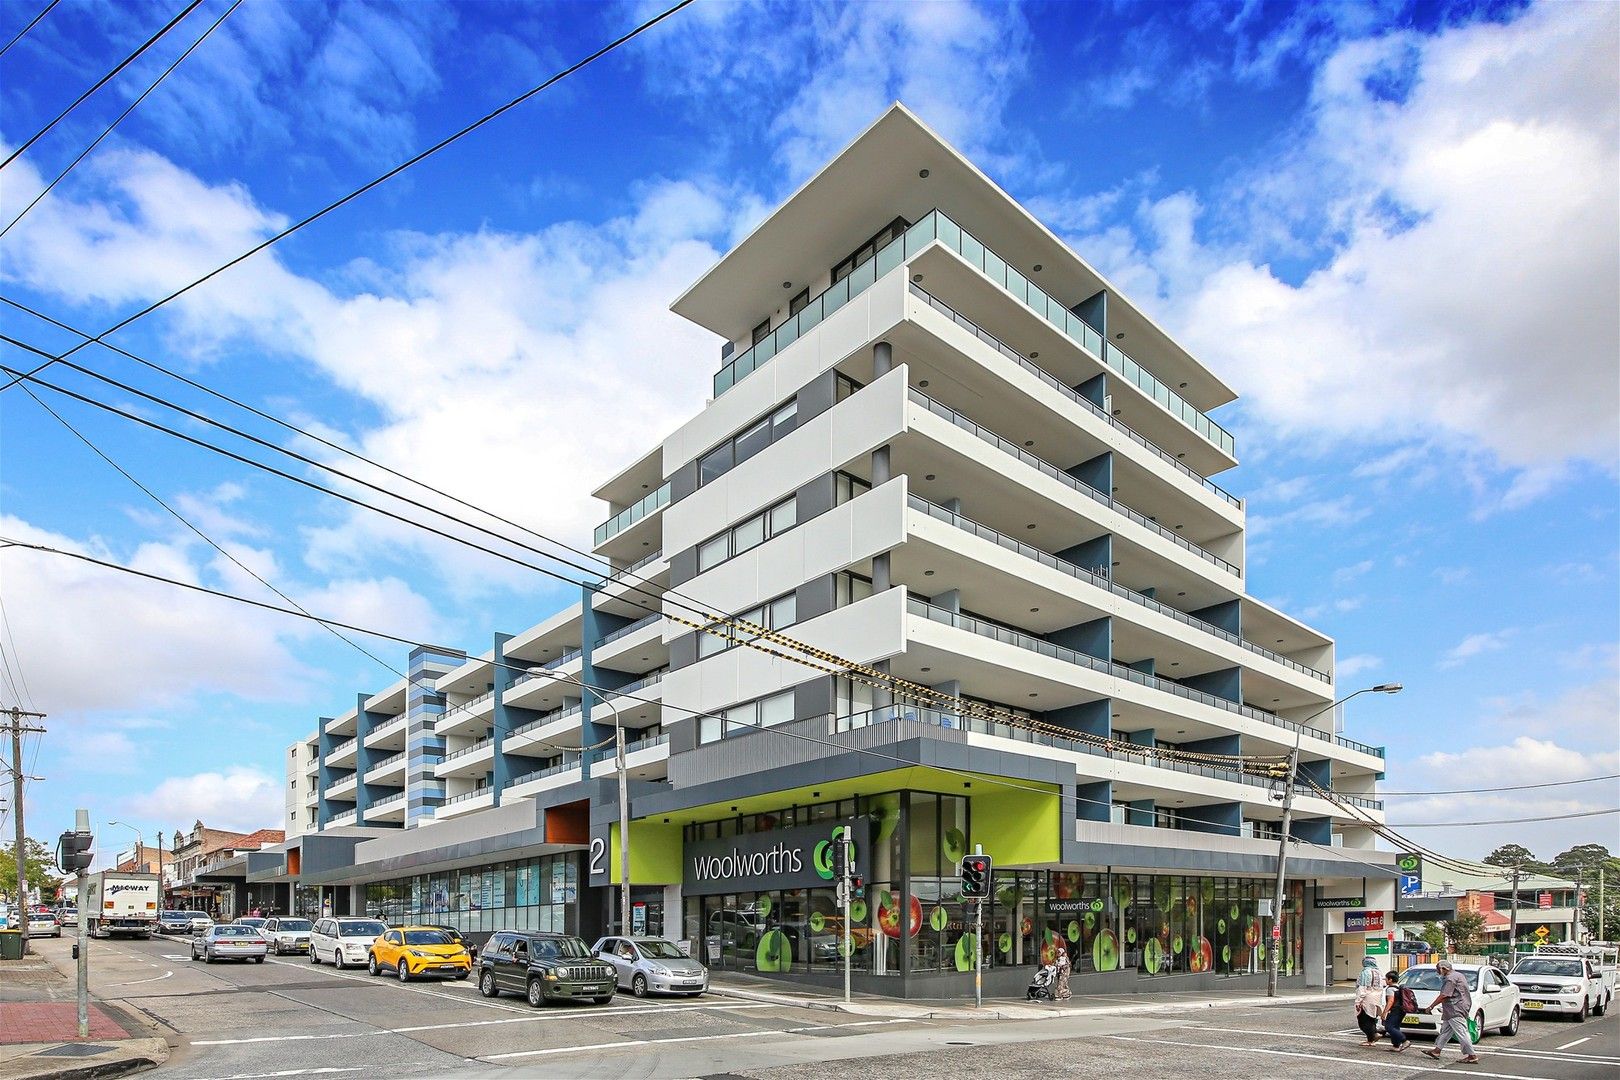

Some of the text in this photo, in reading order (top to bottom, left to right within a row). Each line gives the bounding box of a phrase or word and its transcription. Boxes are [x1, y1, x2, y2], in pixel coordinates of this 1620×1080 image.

[590, 838, 605, 874] 2
[1407, 875, 1419, 888] P
[1049, 901, 1090, 911] woolworths
